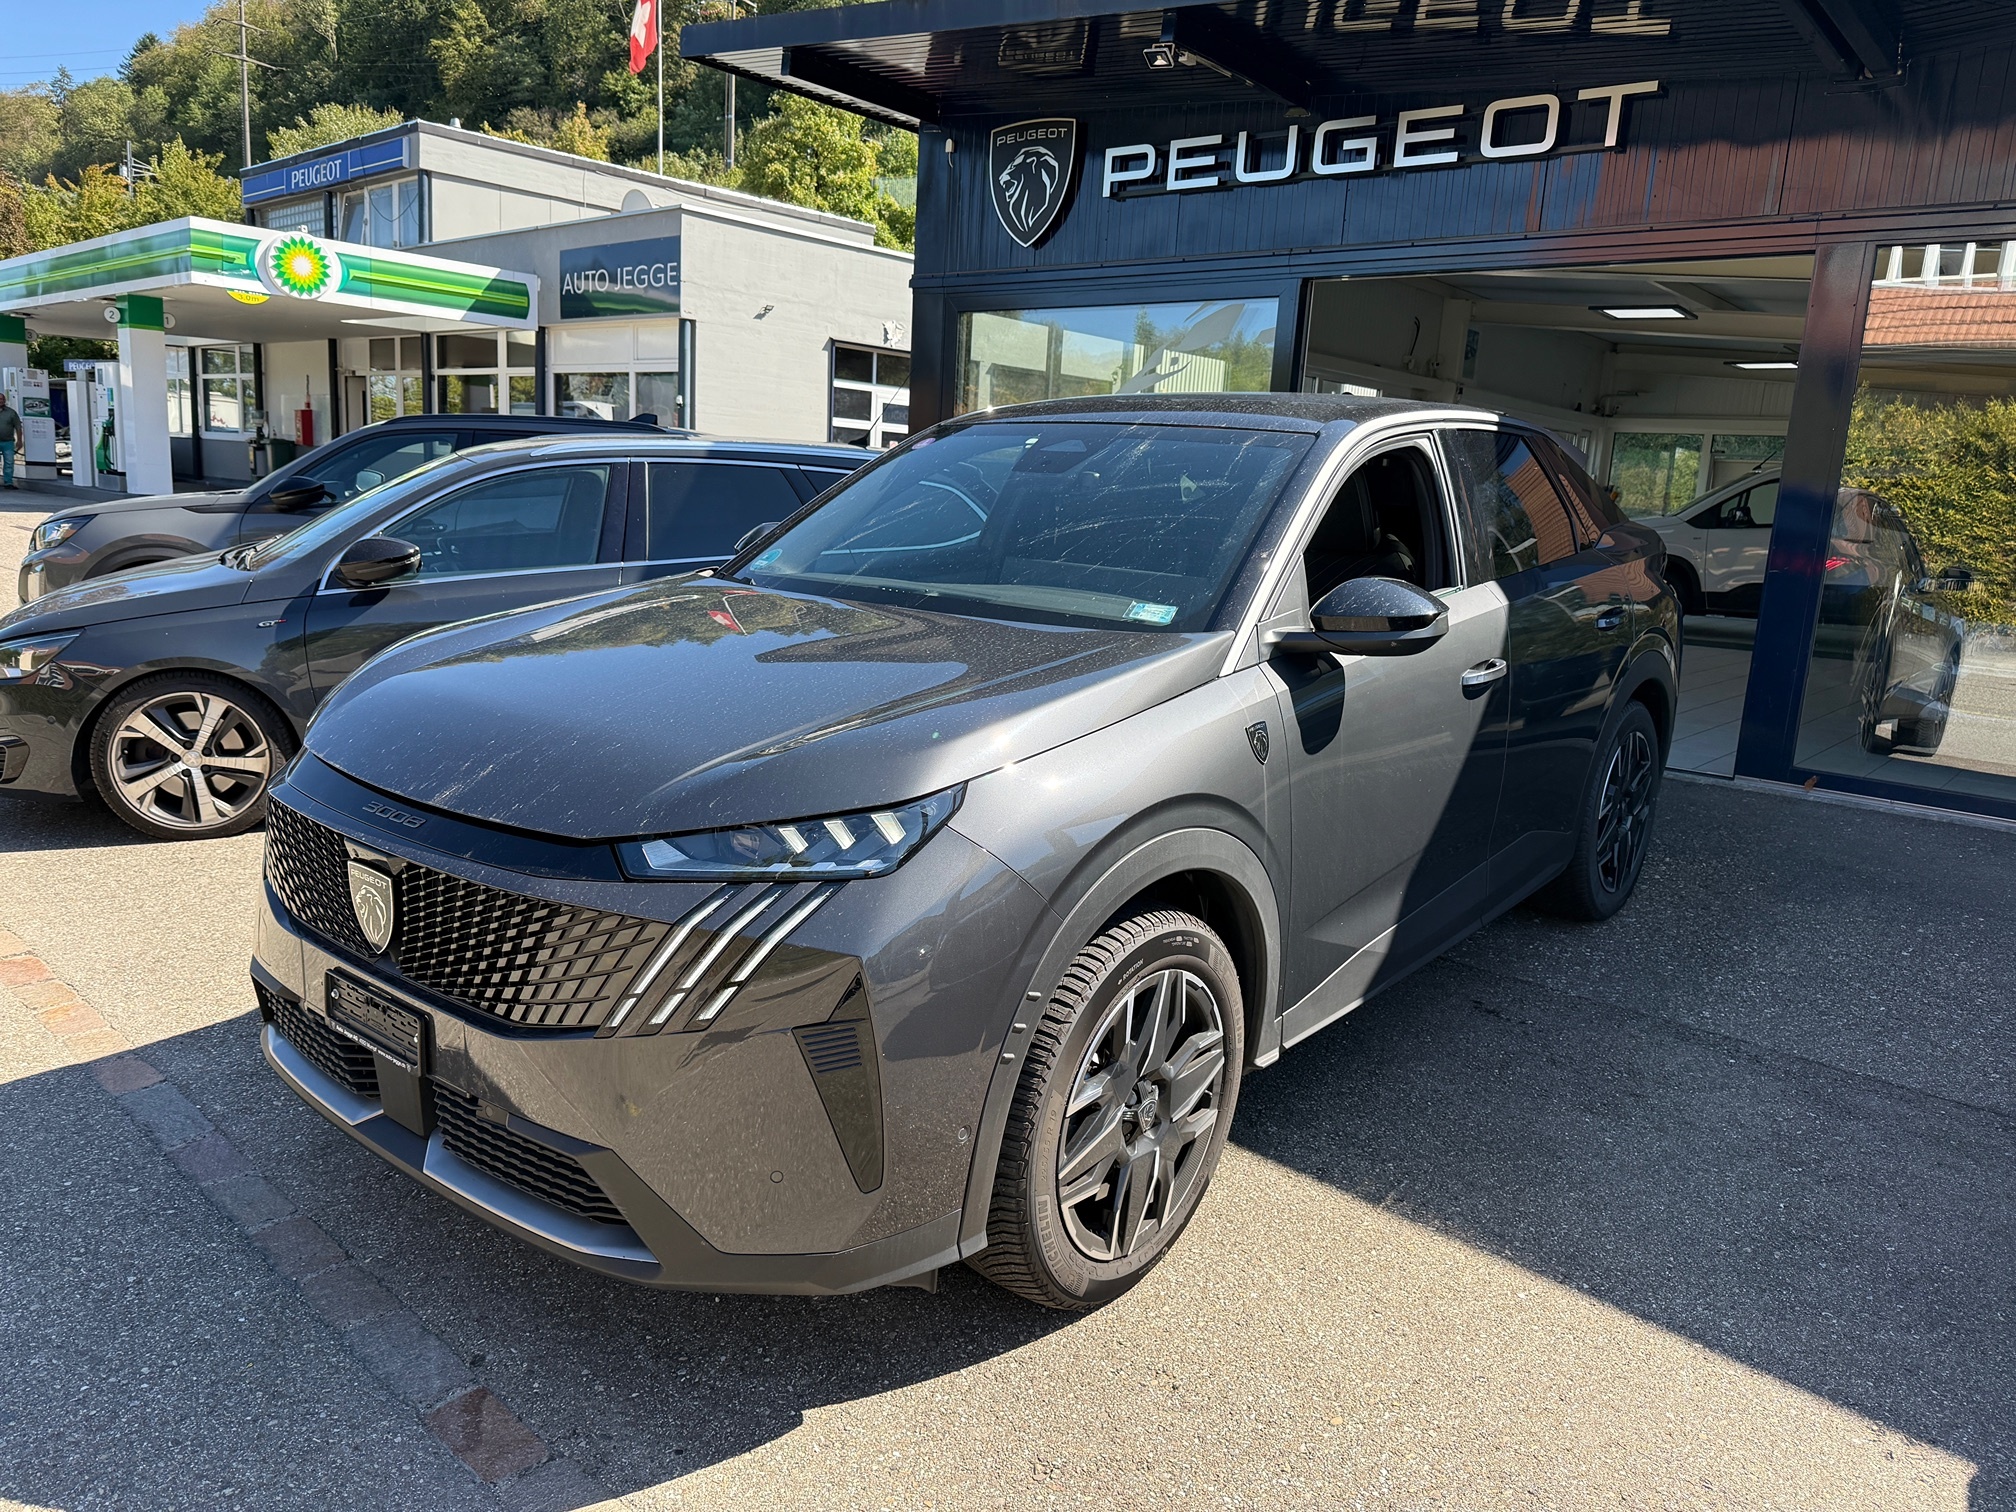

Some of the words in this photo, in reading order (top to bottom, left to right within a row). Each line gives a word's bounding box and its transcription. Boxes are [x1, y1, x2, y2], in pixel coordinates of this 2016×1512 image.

[996, 128, 1068, 147] PEUGEOT
[1102, 80, 1660, 198] PEUGEOT
[291, 159, 342, 189] PEUGEOT
[562, 269, 609, 295] AUTO
[614, 262, 678, 290] JEGGE
[109, 310, 115, 320] 2
[165, 316, 169, 325] 1
[27, 331, 33, 339] 3
[362, 801, 427, 828] 3008
[350, 869, 387, 890] PEUGEOT
[1122, 959, 1144, 981] ROTATION
[1049, 1108, 1058, 1123] 19
[1037, 1200, 1067, 1279] MICHELIN
